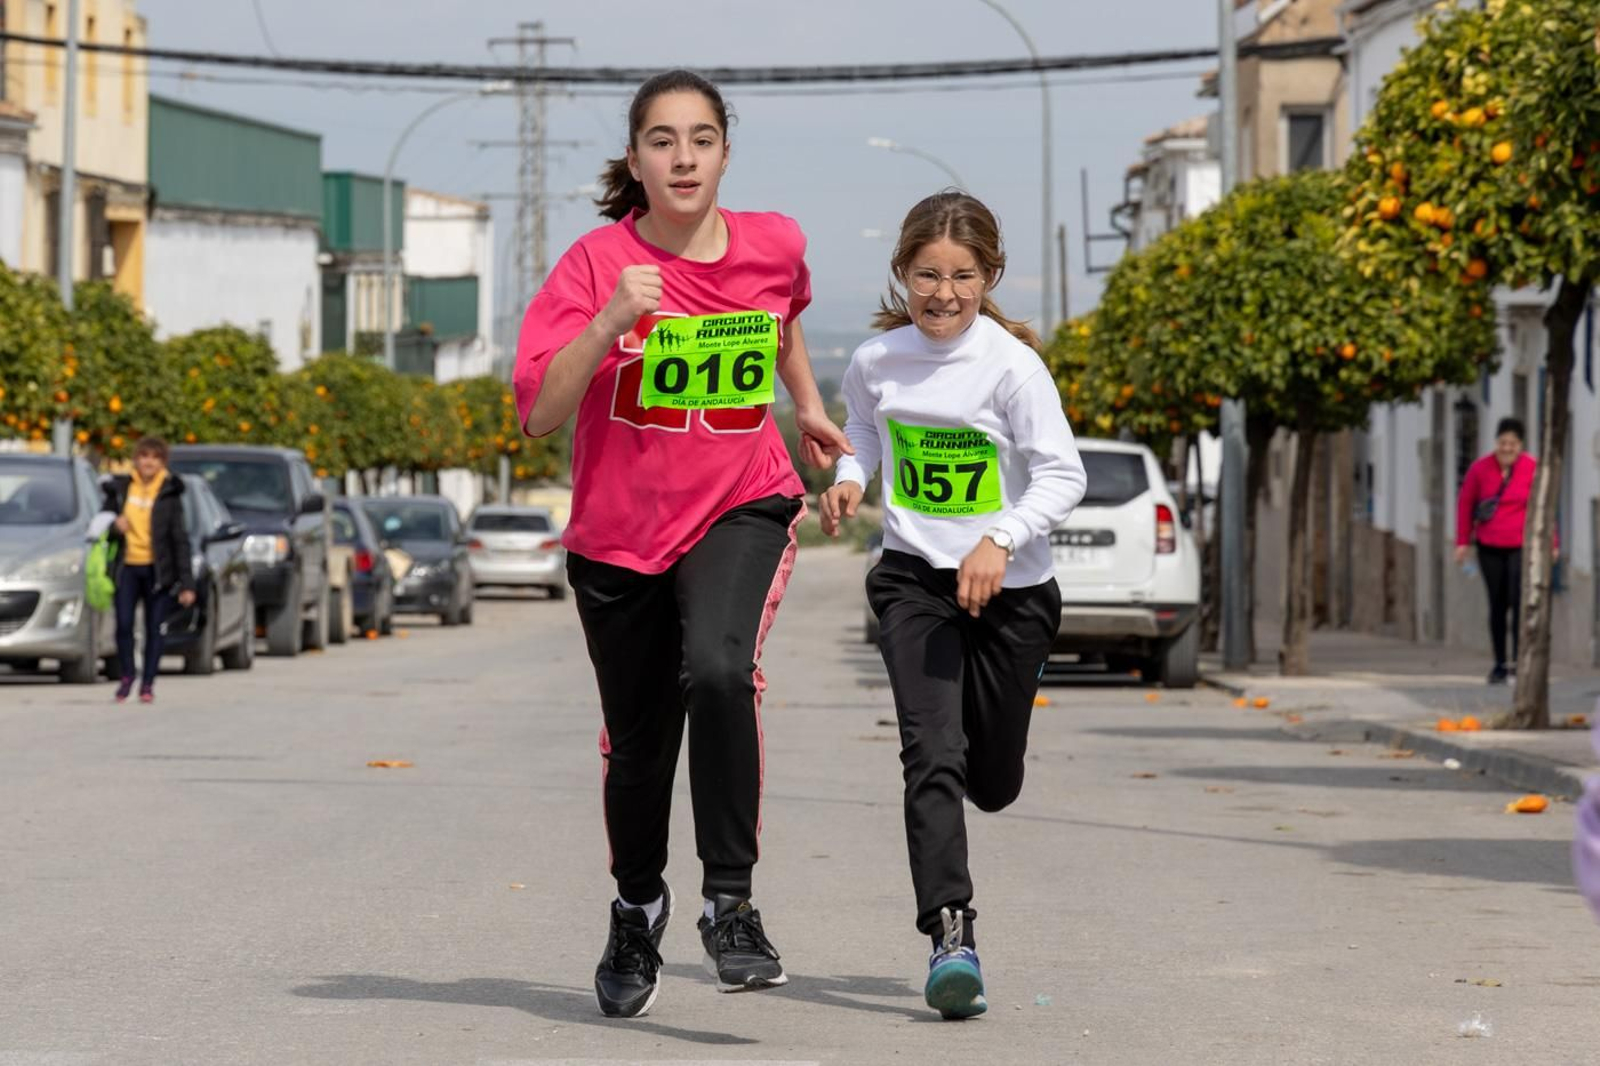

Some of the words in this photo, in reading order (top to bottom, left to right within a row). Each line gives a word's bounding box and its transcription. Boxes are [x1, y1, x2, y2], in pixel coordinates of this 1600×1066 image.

[702, 314, 764, 328] CIRCUITO
[696, 324, 771, 339] RUNNING
[698, 340, 721, 349] Monte
[723, 338, 741, 348] Lope
[743, 336, 768, 346] Álvarez
[653, 350, 766, 395] 016
[672, 398, 686, 406] DÍA
[688, 398, 699, 406] DE
[701, 397, 745, 406] ANDALUCÍA
[925, 431, 983, 440] CIRCUITO
[920, 438, 990, 450] RUNNING
[922, 450, 943, 458] Monte
[963, 449, 988, 458] Álvarez
[899, 458, 988, 503] 057
[922, 505, 931, 513] DE
[932, 506, 974, 514] ANDALUCÍA
